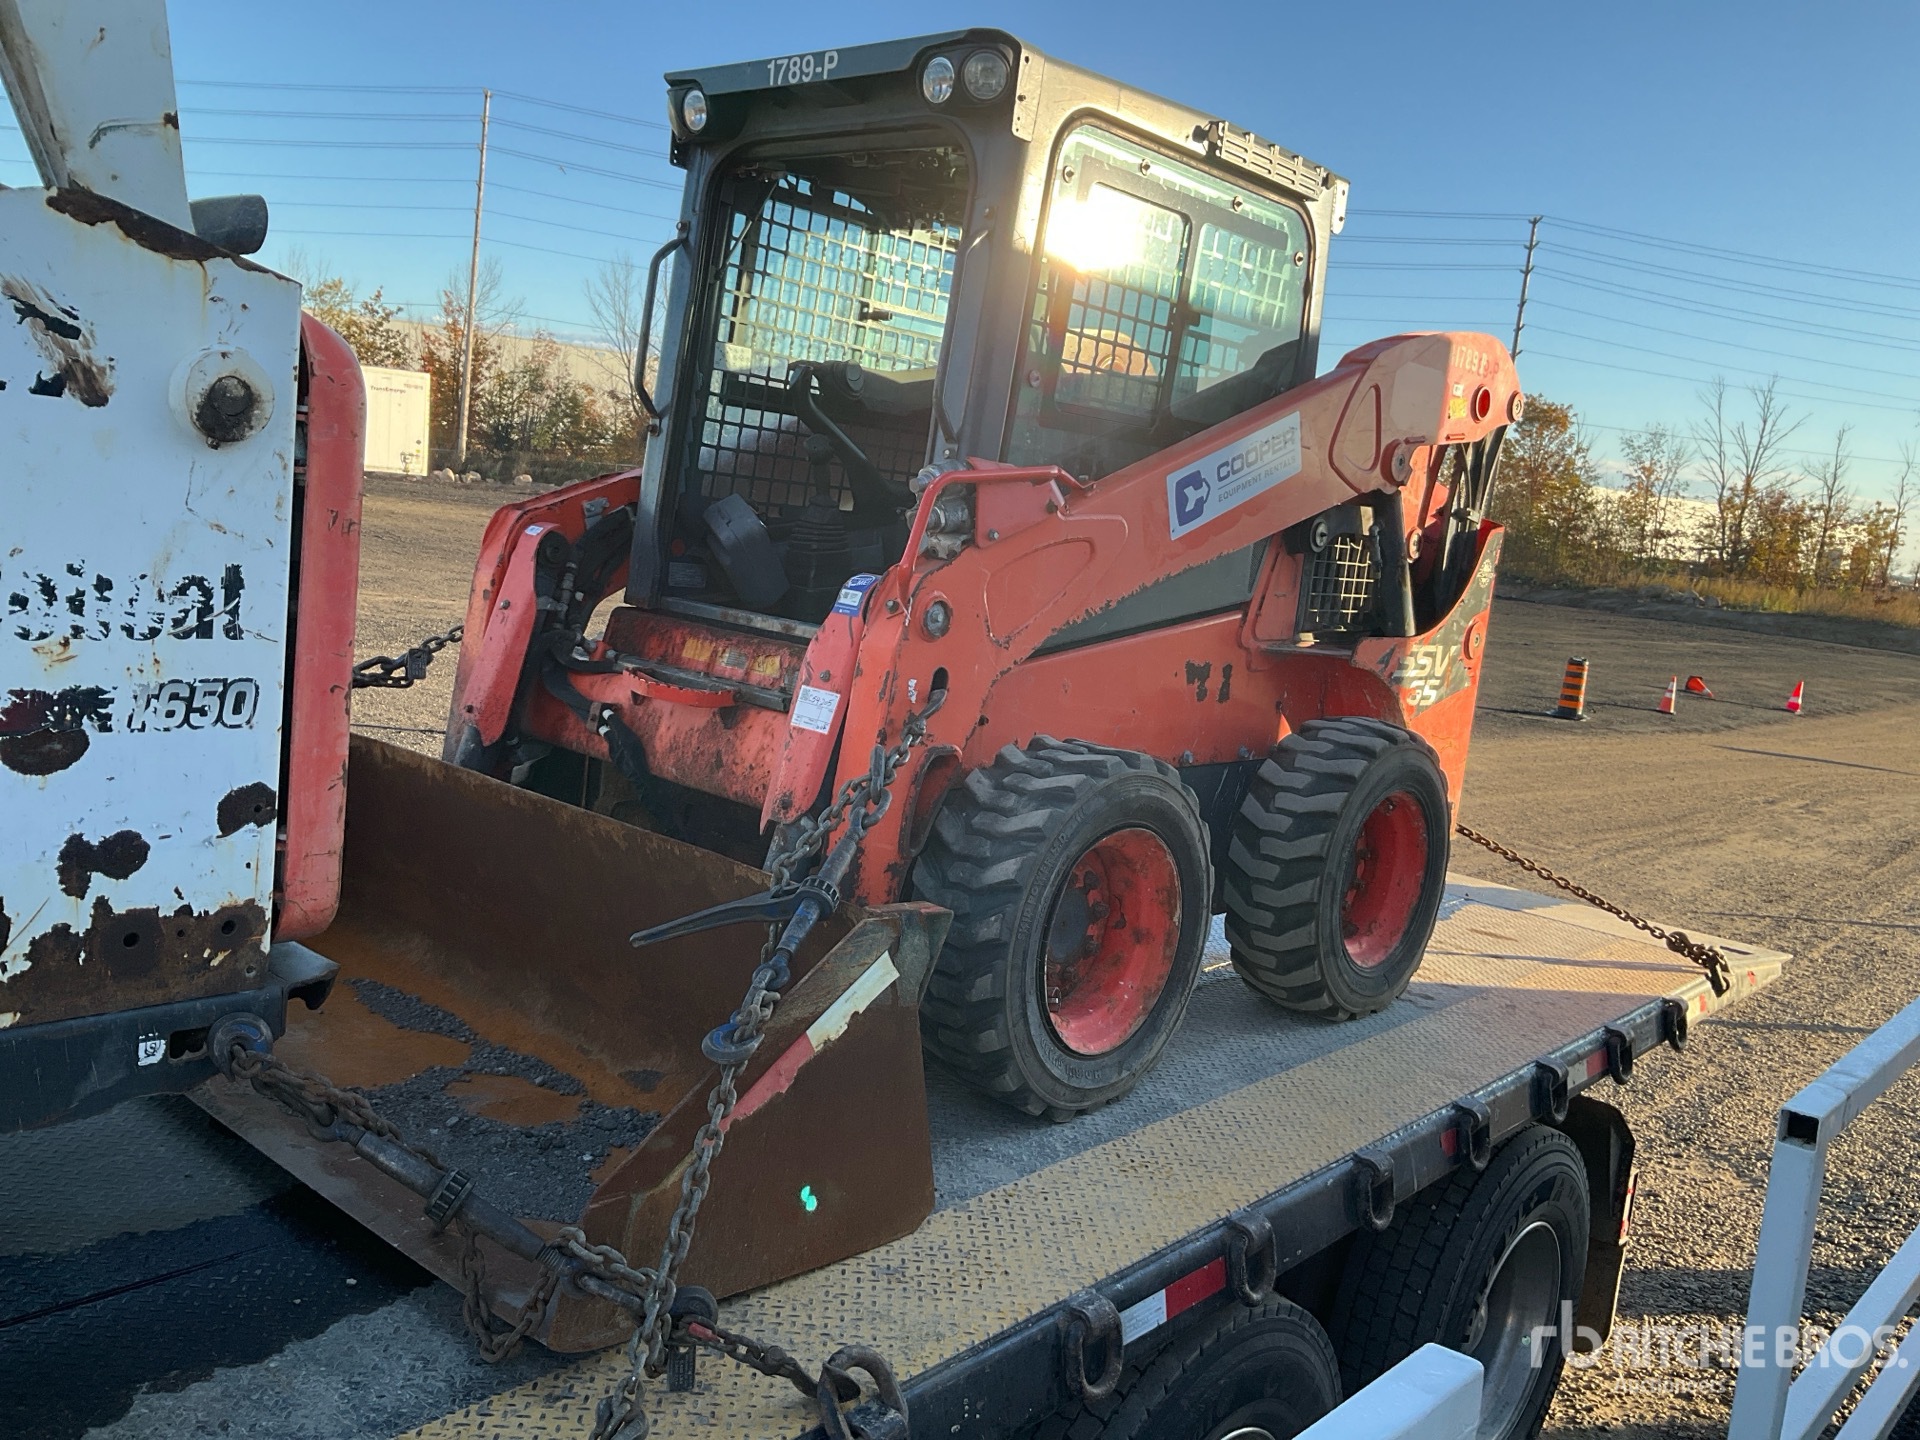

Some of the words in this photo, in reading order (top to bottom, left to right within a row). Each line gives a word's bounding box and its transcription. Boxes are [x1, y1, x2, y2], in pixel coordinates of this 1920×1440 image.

[767, 50, 838, 86] 1789-P
[1216, 427, 1297, 483] COOPER
[1218, 473, 1262, 503] EQUIPMENT
[1264, 456, 1296, 479] RENTALS
